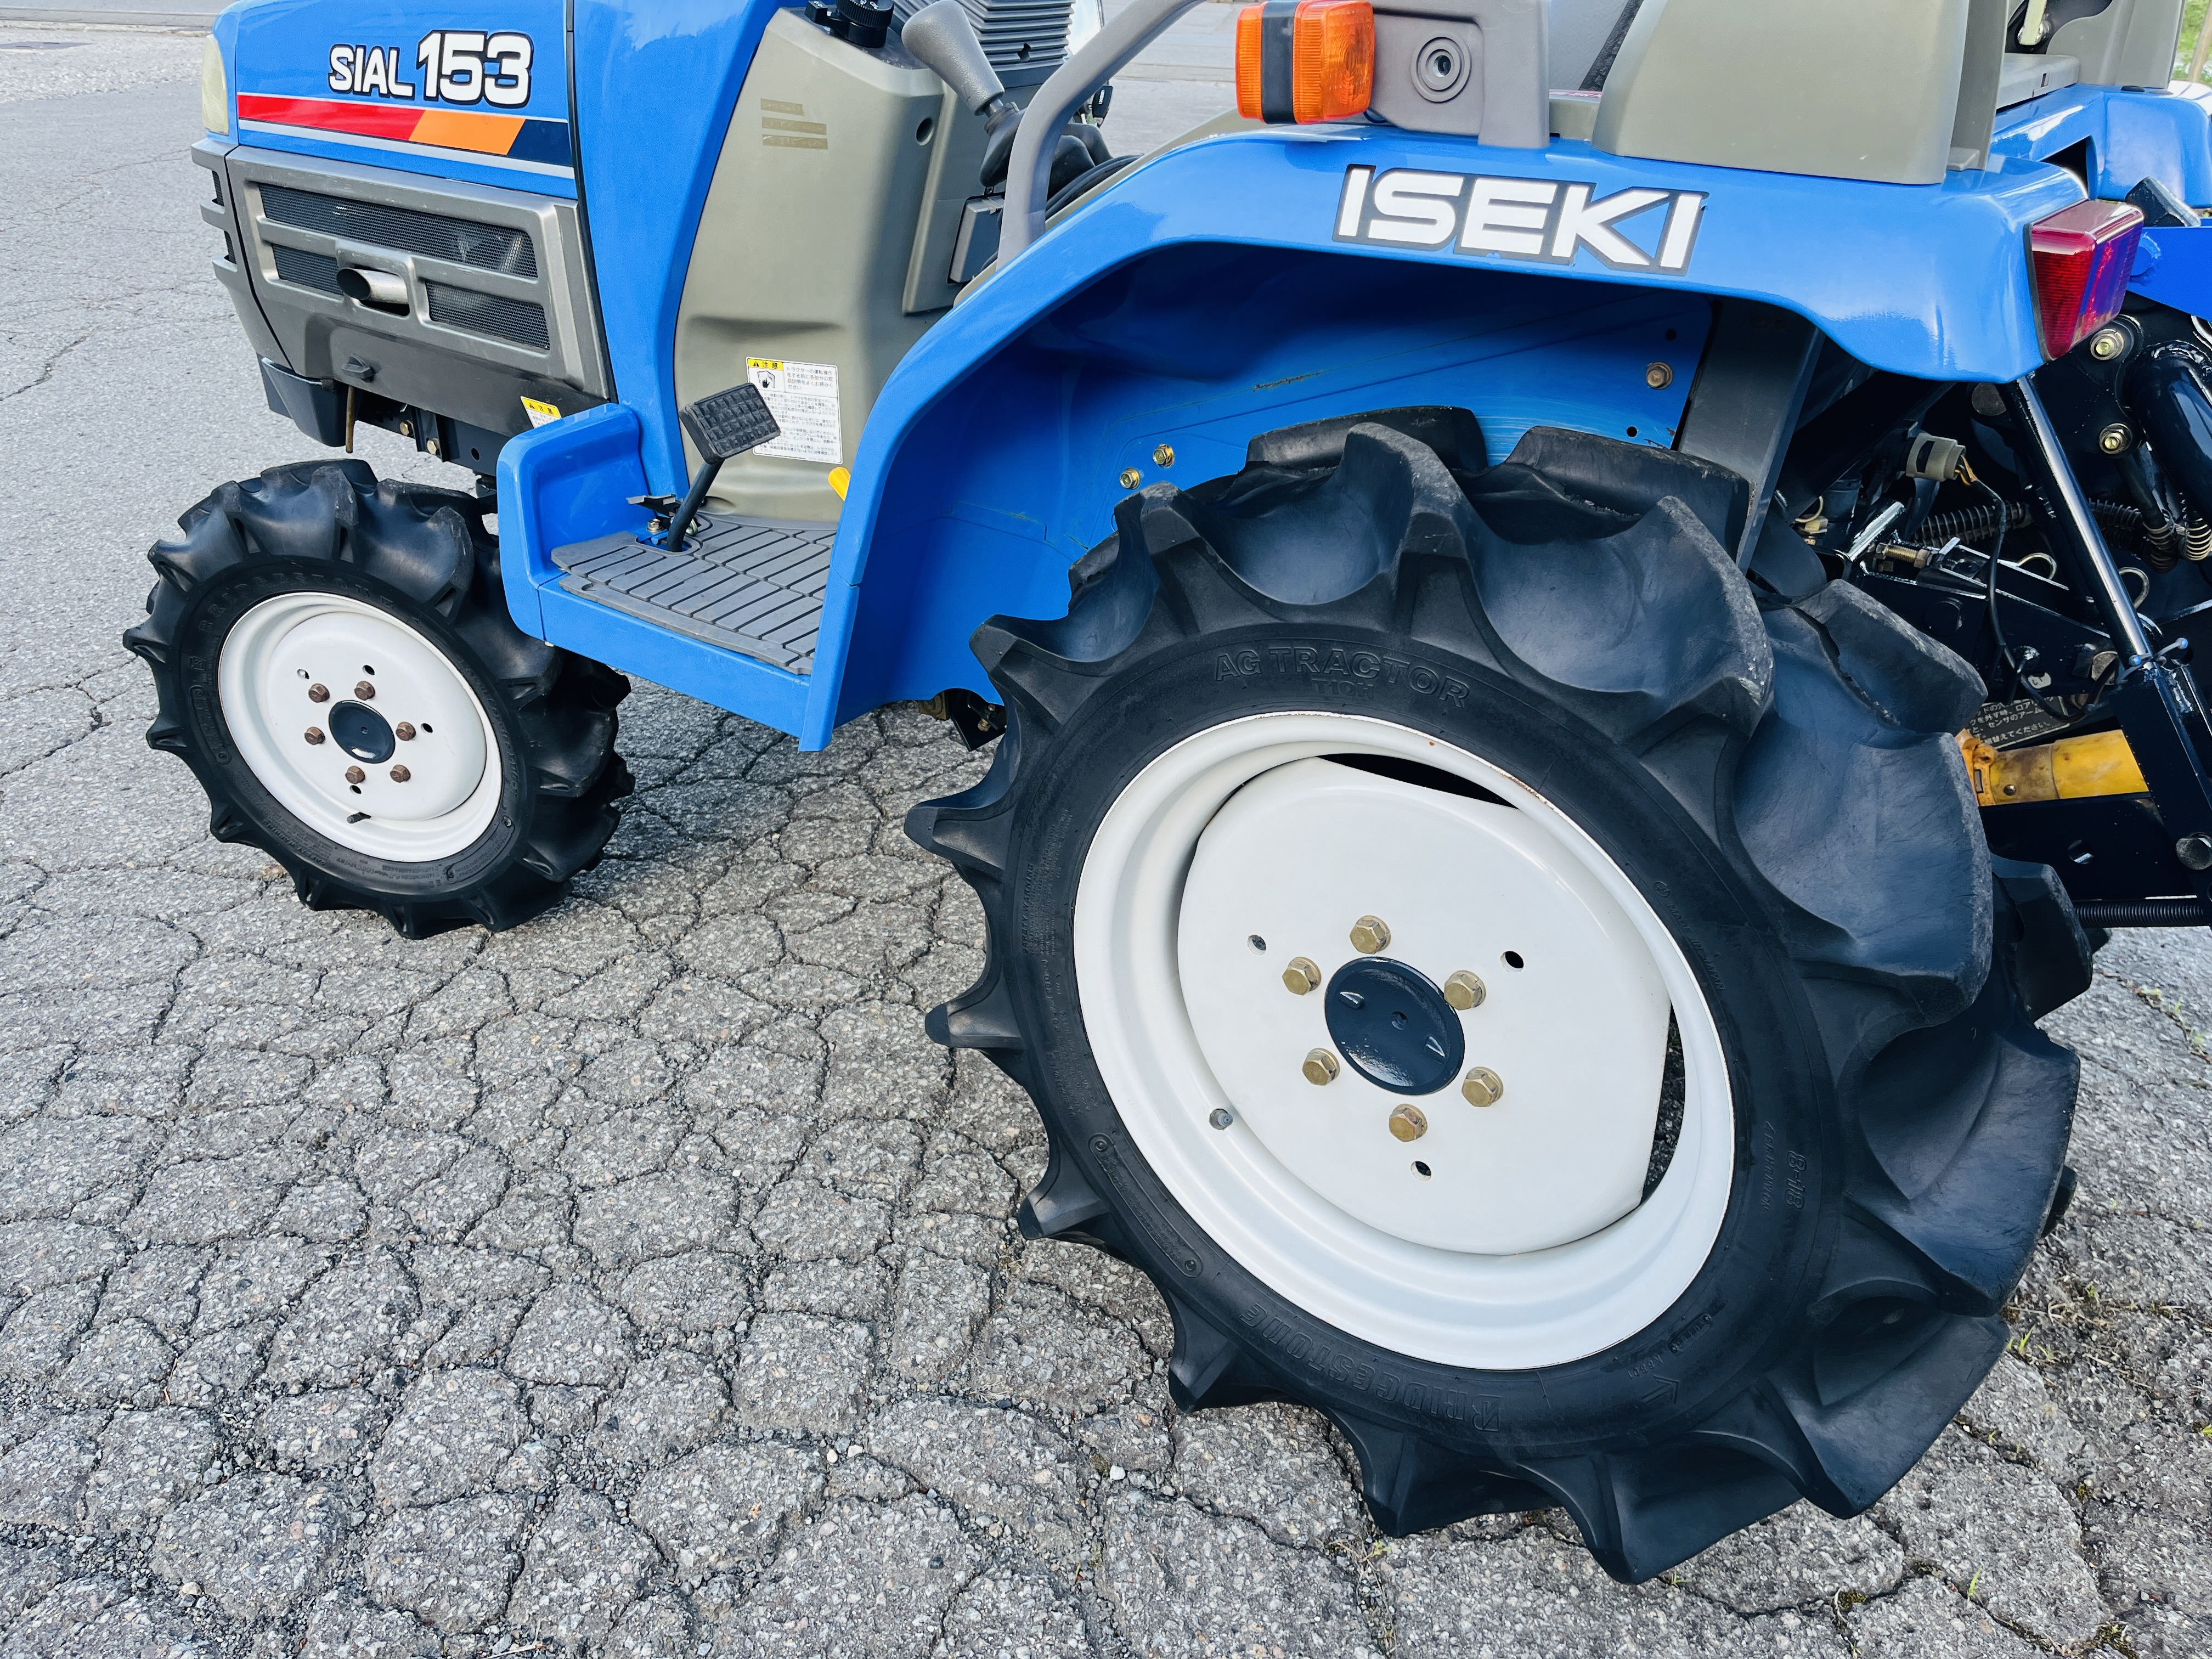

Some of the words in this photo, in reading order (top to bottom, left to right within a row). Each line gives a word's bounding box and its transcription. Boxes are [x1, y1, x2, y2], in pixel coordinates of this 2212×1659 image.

[329, 44, 415, 99] SIAL
[417, 30, 533, 108] 153
[1334, 165, 1708, 275] ISEKI
[1215, 649, 1262, 682] AG
[1268, 646, 1470, 709] TRACTOR
[1786, 1150, 1807, 1210] 8-18
[1238, 1301, 1504, 1433] BRIDGESTONE
